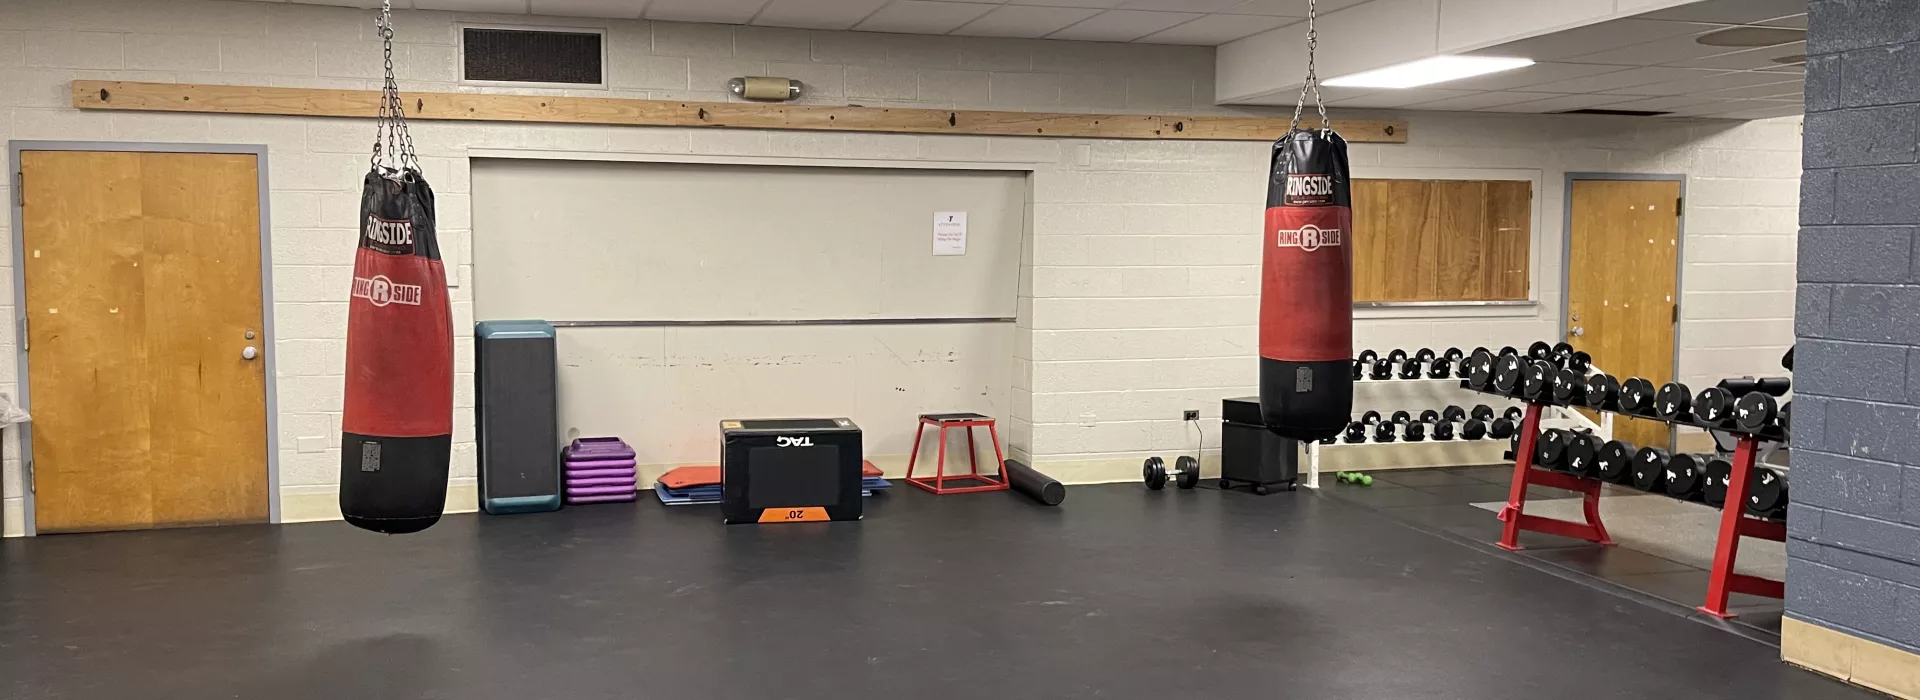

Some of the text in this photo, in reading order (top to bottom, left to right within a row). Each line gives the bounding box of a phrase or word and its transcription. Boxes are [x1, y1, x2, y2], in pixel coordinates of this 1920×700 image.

[1286, 176, 1333, 196] RINGSIDE
[1279, 229, 1340, 247] RING R SIDE
[372, 280, 389, 302] R
[393, 285, 420, 303] SIDE
[776, 435, 814, 448] TAG
